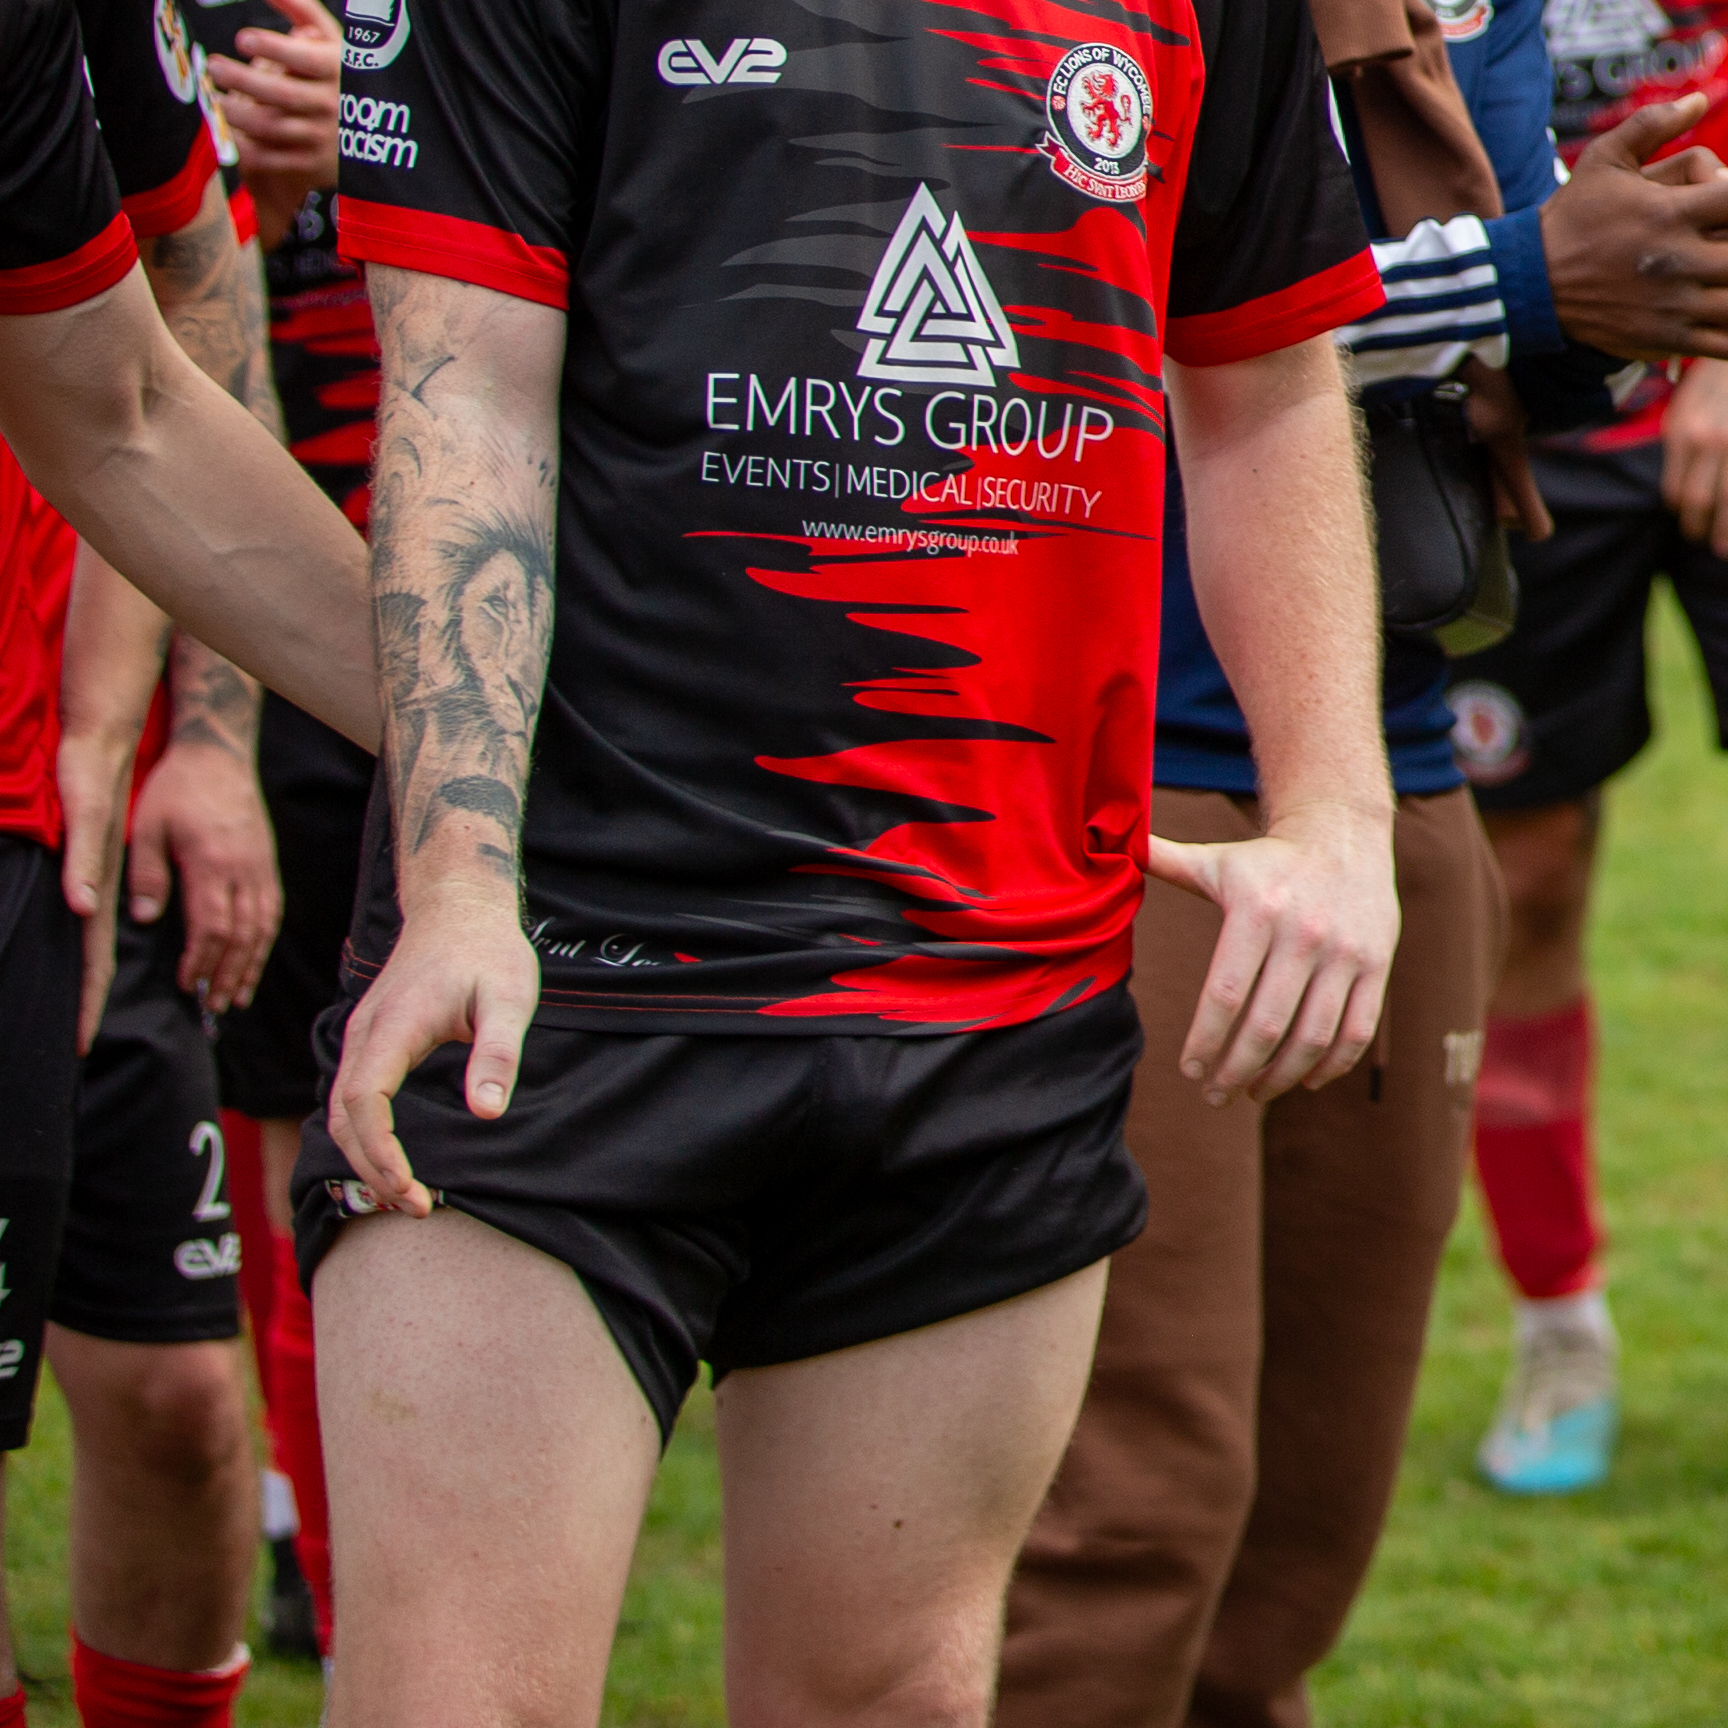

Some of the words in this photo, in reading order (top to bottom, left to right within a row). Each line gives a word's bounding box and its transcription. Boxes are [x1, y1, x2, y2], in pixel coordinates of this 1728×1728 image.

[348, 26, 381, 44] 1967
[657, 37, 788, 86] EV2
[1060, 48, 1093, 77] LIONS
[1091, 48, 1111, 63] OF
[1053, 77, 1069, 95] FC
[1112, 50, 1151, 115] WYCOMBE
[706, 372, 906, 446] EMRYS
[924, 390, 1115, 464] GROUP
[701, 451, 831, 493] EVENTS
[846, 463, 974, 507] MEDICAL
[982, 476, 1102, 519] SECURITY
[801, 519, 1019, 558] www.emrysgroup.co.uk
